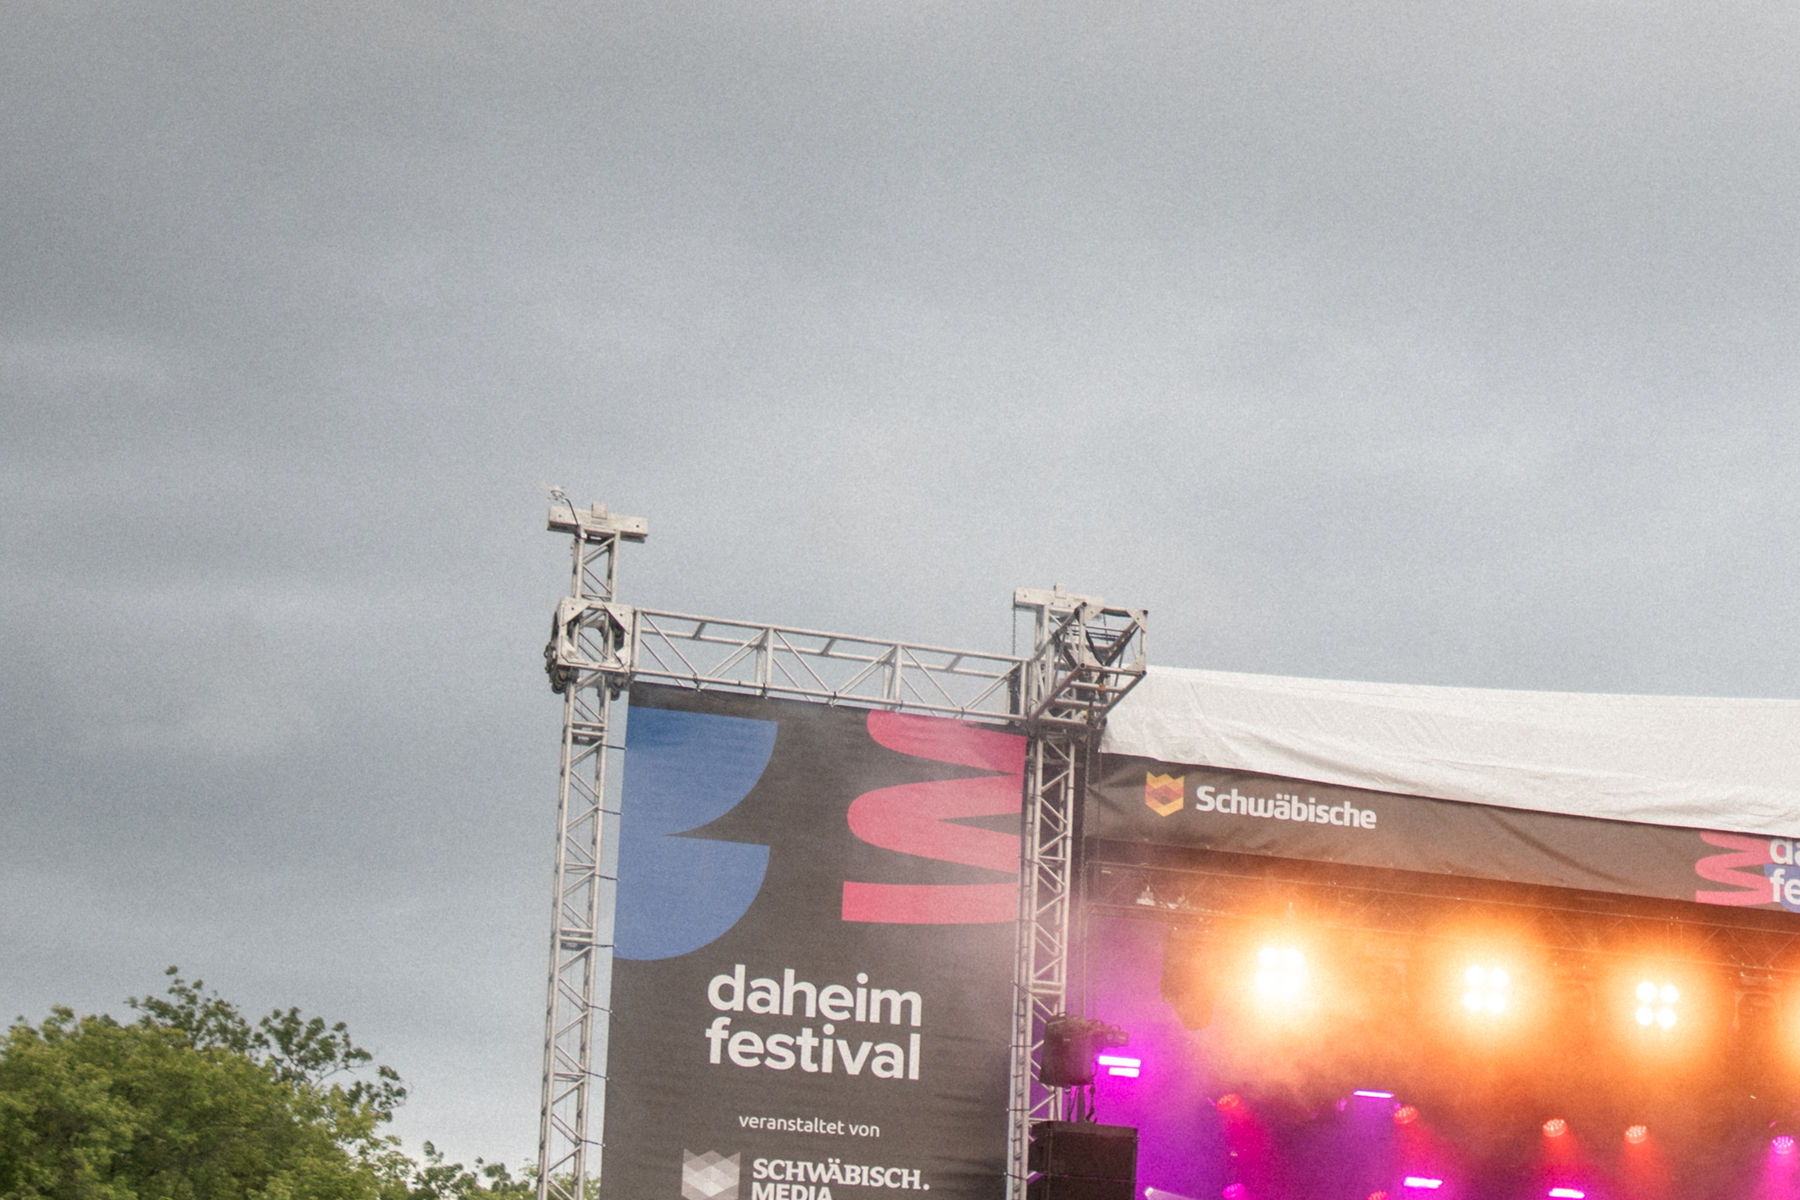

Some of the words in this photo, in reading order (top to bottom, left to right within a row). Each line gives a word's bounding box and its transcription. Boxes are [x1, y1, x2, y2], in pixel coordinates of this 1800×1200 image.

[1195, 785, 1377, 829] Schwäbische
[707, 964, 922, 1027] daheim
[705, 1016, 921, 1080] festival
[739, 1115, 845, 1135] veranstaltet
[849, 1123, 880, 1137] von
[752, 1158, 930, 1191] SCHWÄBISCH.
